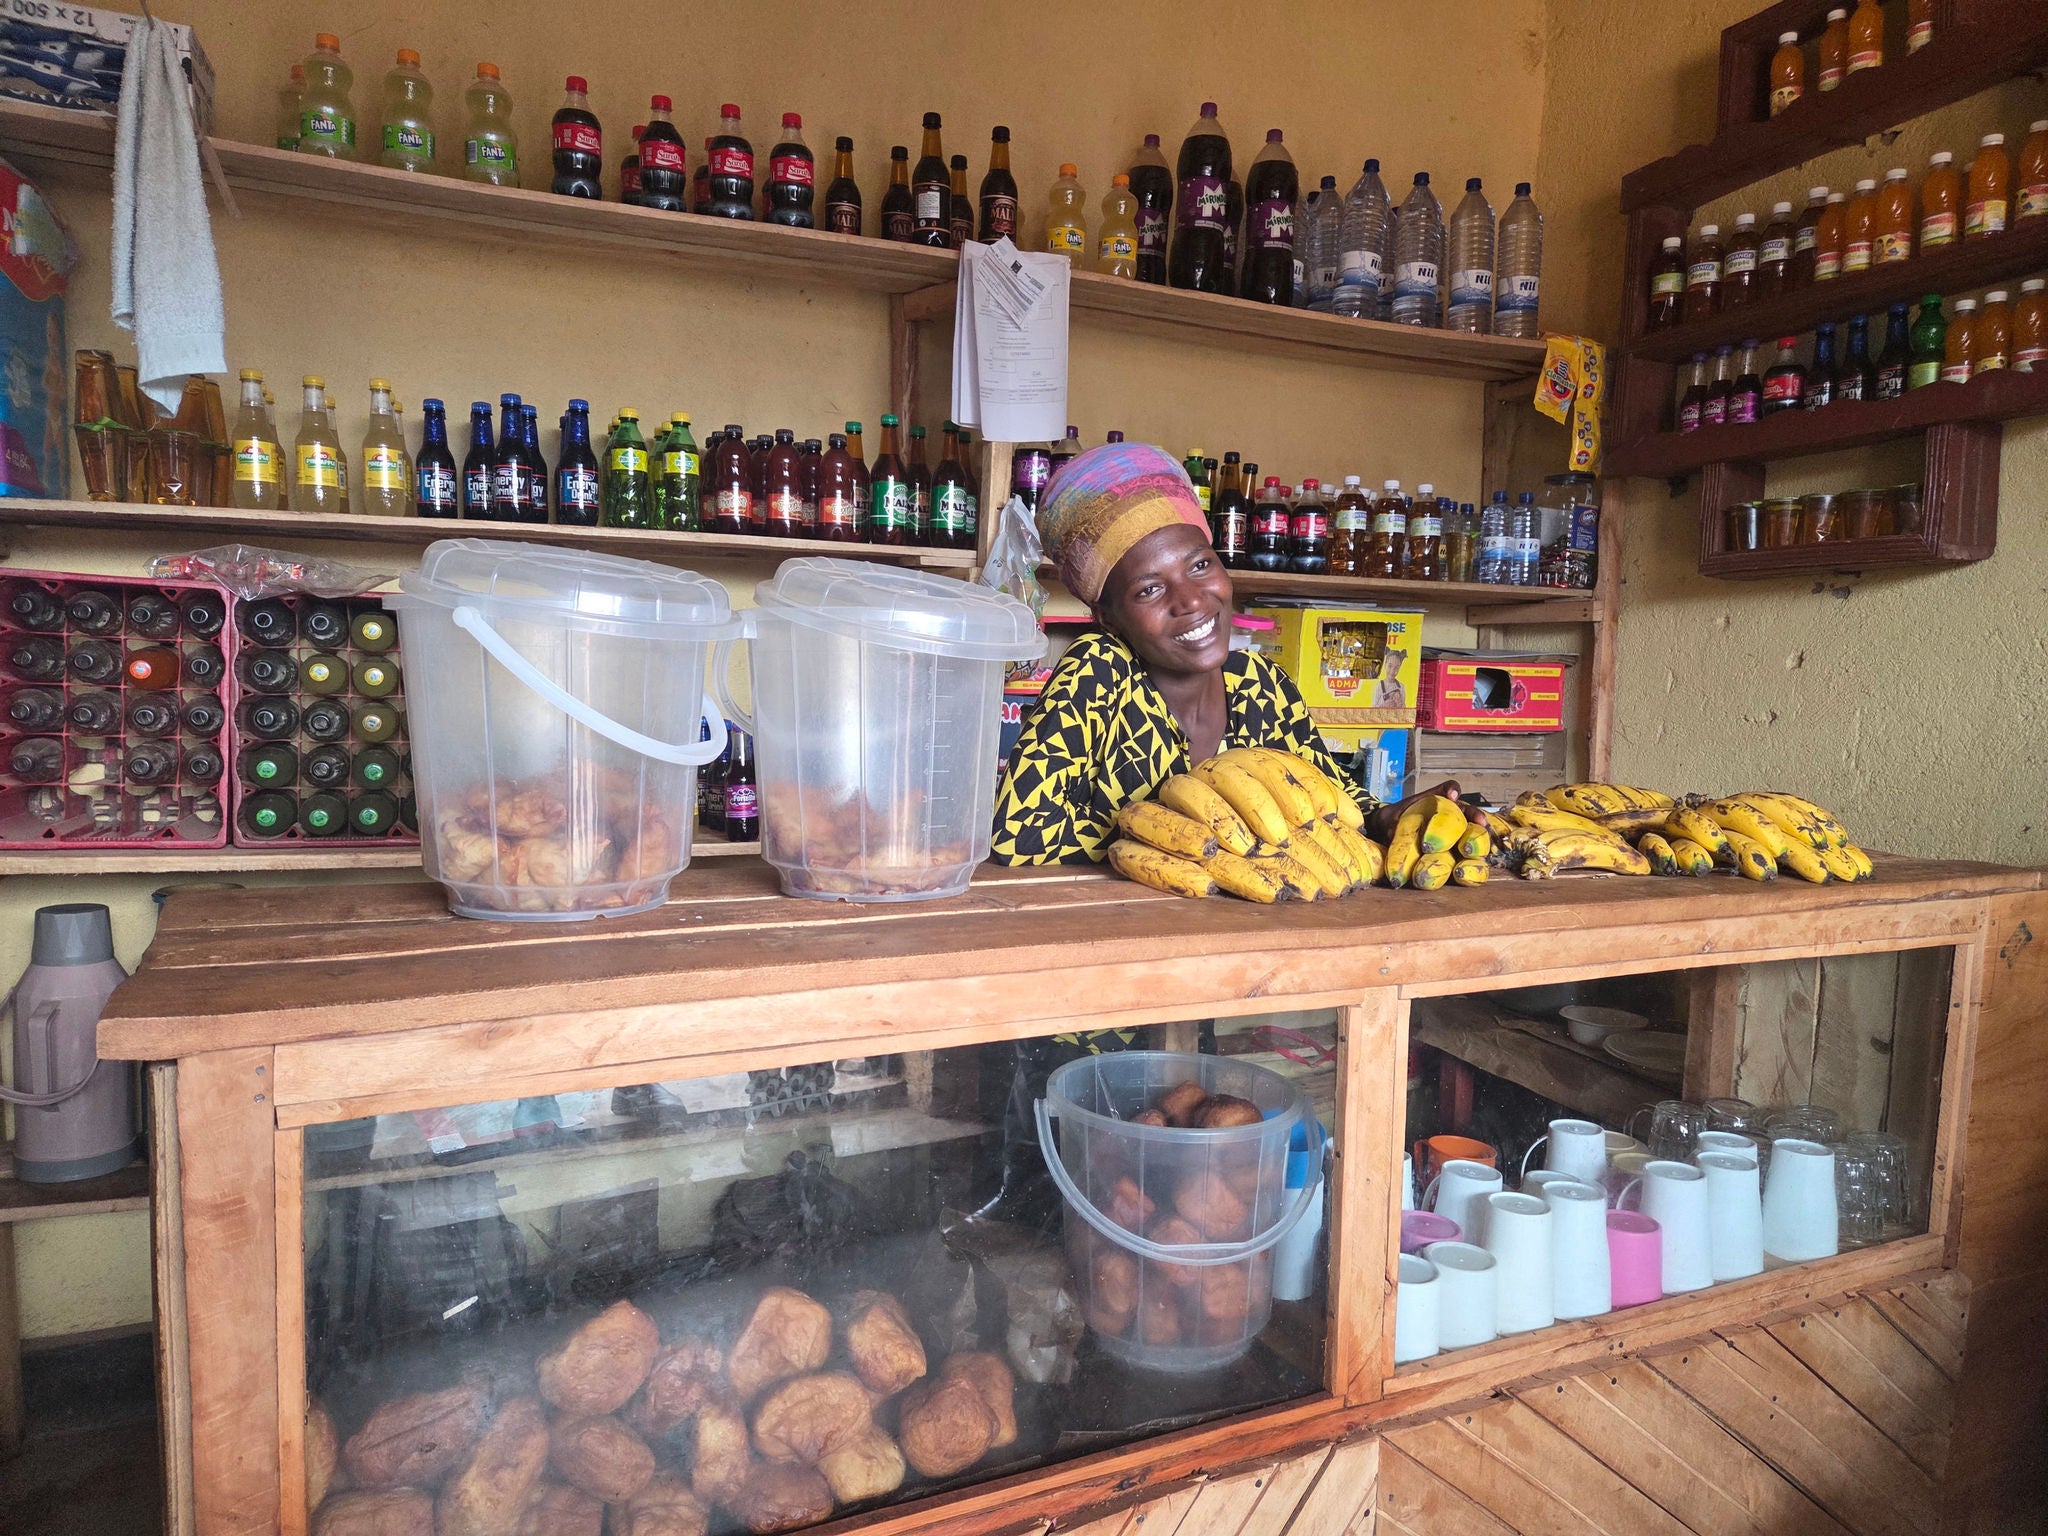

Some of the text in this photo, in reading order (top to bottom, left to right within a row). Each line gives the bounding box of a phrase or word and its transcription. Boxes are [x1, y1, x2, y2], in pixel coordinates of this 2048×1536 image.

[73, 9, 95, 26] 12
[311, 119, 337, 131] FANTA
[398, 132, 423, 145] FANTA
[481, 146, 505, 158] FANTA
[1417, 268, 1434, 278] Nil
[1520, 281, 1536, 291] Nil
[237, 453, 270, 462] PINEPPLE
[494, 475, 525, 490] nergy
[1328, 679, 1359, 689] ADMA
